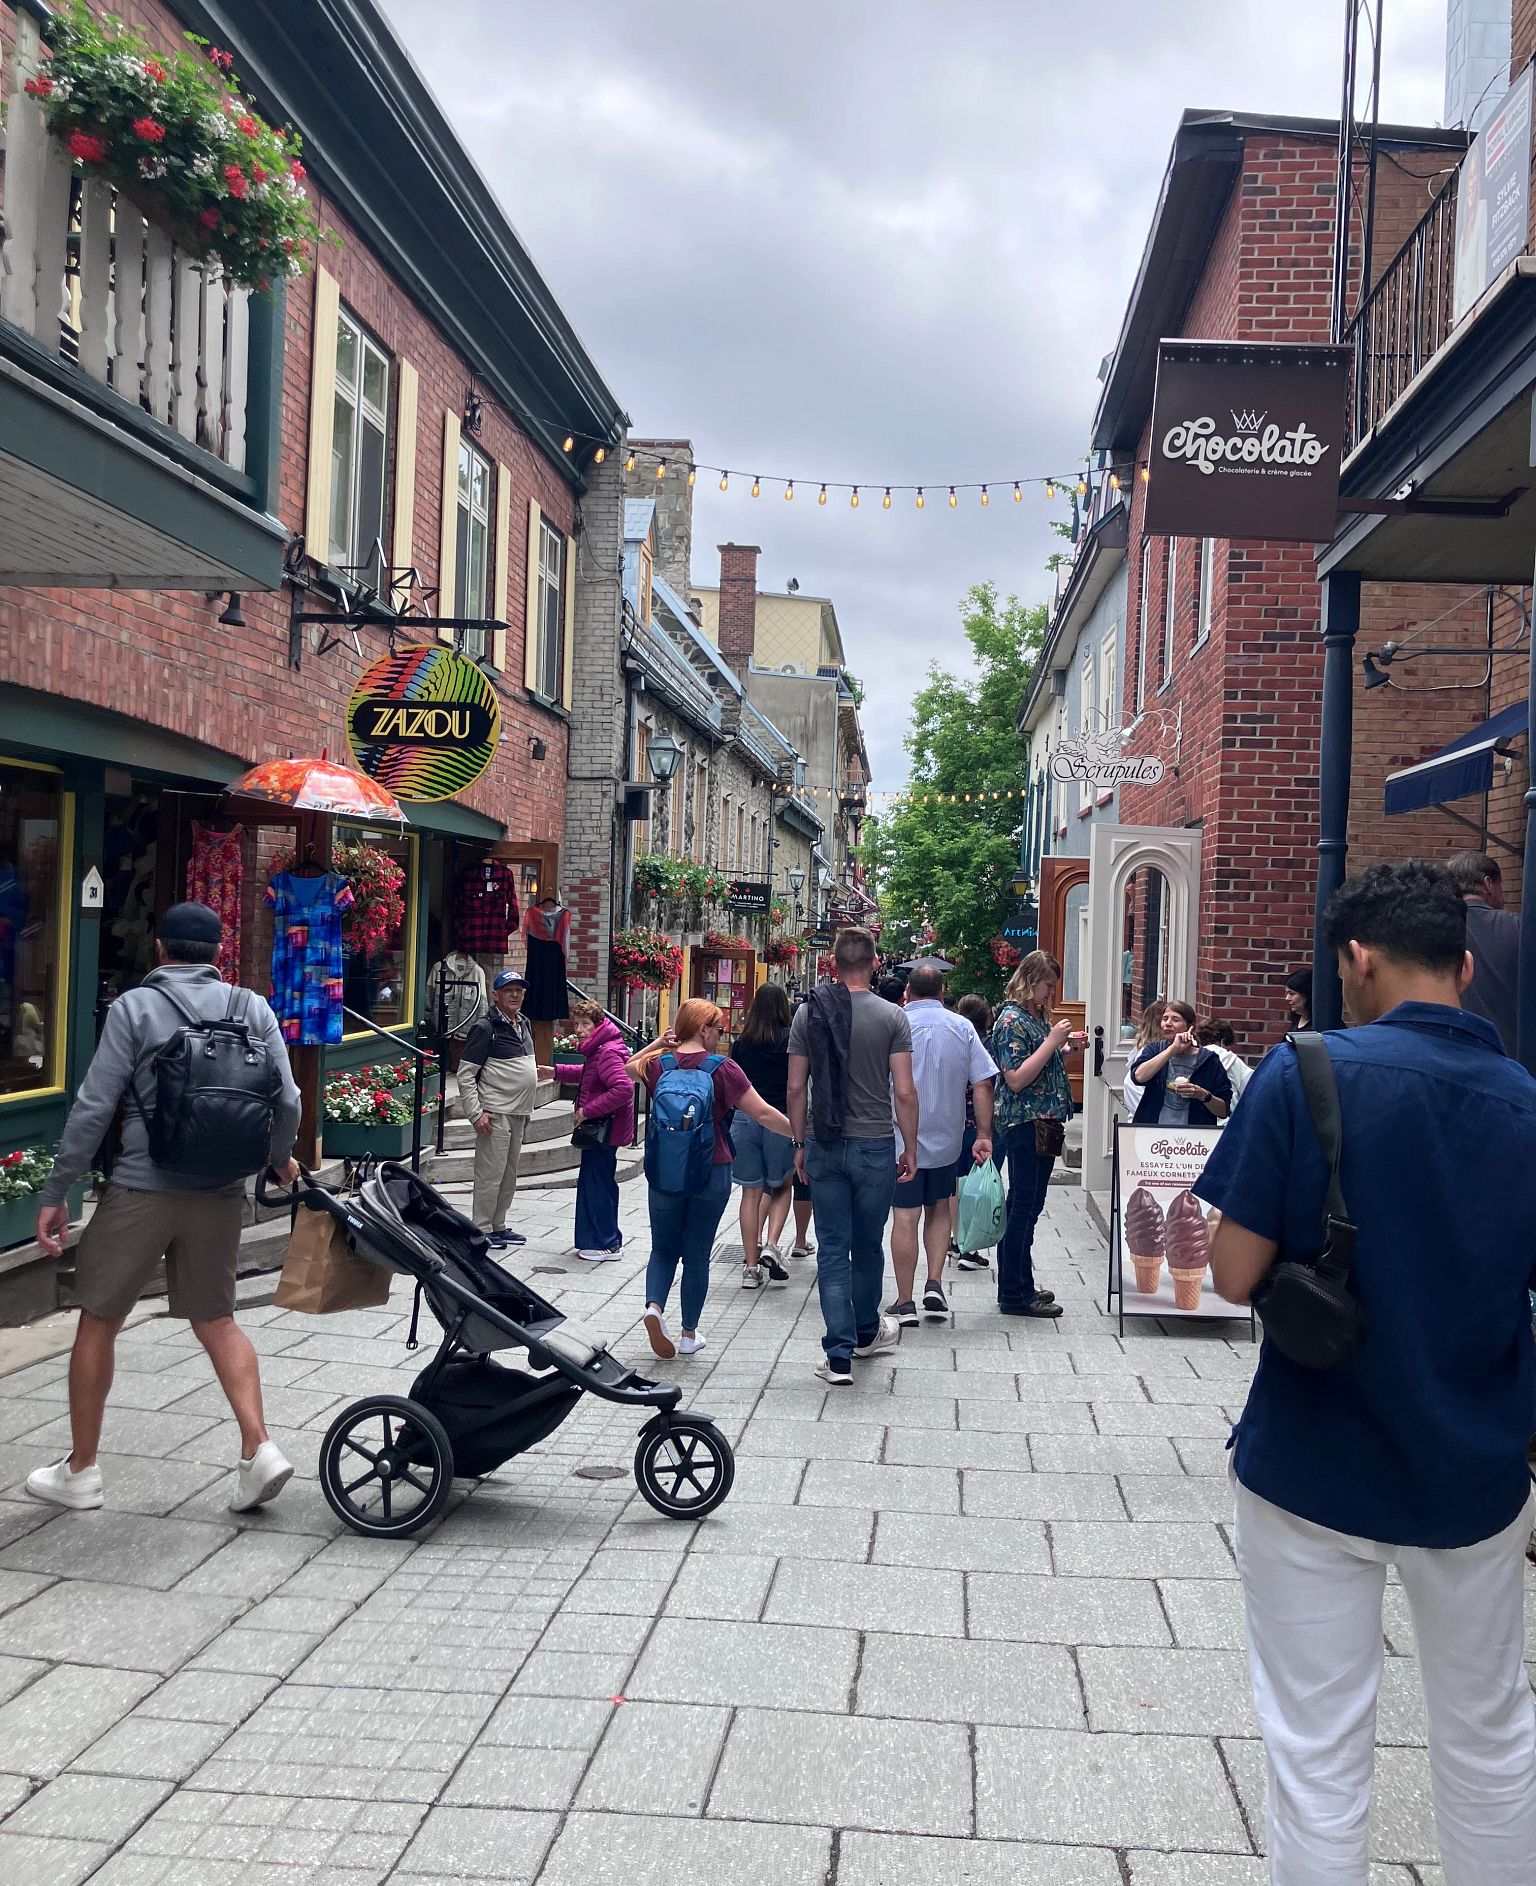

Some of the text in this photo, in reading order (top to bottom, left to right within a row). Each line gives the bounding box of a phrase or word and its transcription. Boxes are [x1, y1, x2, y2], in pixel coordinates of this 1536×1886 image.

[1497, 171, 1517, 205] SYLVIE
[1492, 184, 1521, 229] FITZBACK
[1162, 416, 1330, 475] Chocolato
[1218, 466, 1260, 475] Chocolaterie
[1267, 468, 1289, 476] crème
[1289, 469, 1312, 478] glacée
[370, 707, 470, 739] ZAZOU
[1054, 757, 1160, 786] Scrupules
[89, 886, 98, 899] 31
[730, 893, 765, 902] MARTINO
[1150, 1139, 1210, 1160] Chocolato
[1160, 1171, 1197, 1179] CORNETS
